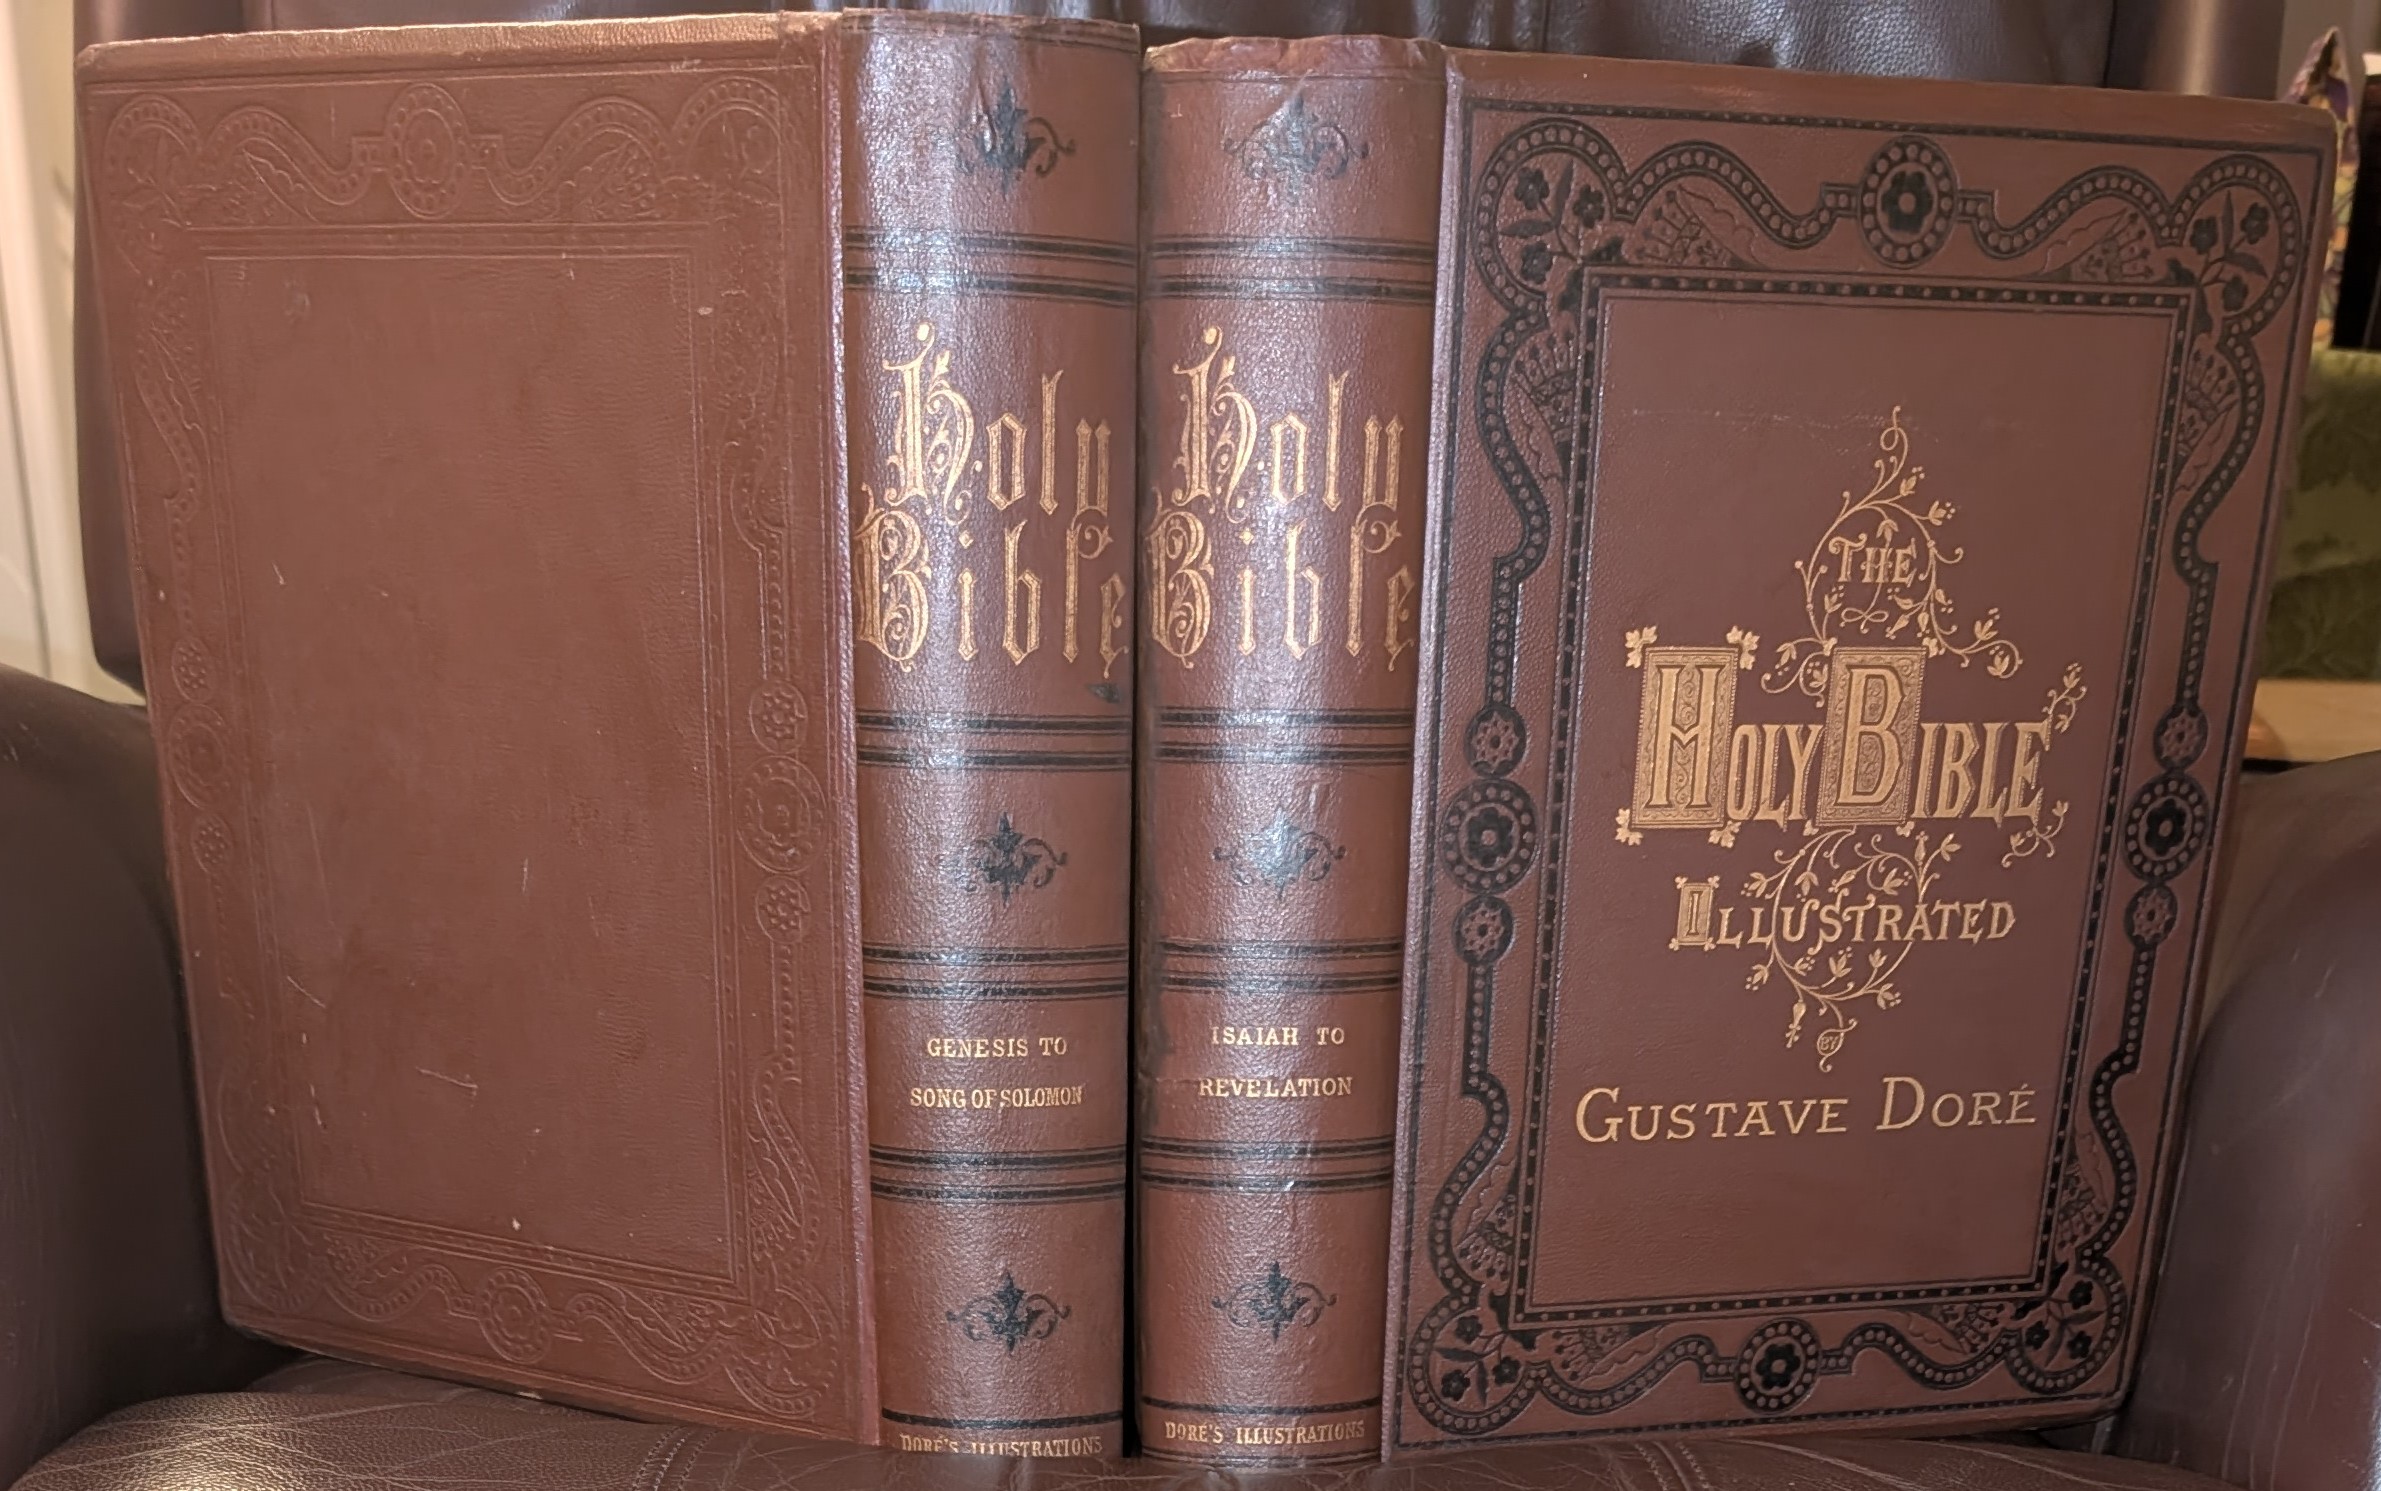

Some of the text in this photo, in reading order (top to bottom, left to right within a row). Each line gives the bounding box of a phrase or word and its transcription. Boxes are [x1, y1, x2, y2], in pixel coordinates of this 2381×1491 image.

[883, 322, 1112, 526] Holy
[1172, 326, 1404, 523] Holy
[854, 483, 1129, 678] Bible
[1144, 487, 1415, 671] Bible
[1828, 533, 1918, 588] THE
[1677, 883, 2016, 952] ILLUSTRATED
[927, 1036, 1067, 1058] GENESIS TO
[1211, 1026, 1345, 1046] ISAIAH TO
[1820, 1036, 1839, 1051] BY
[910, 1085, 1084, 1109] SONG OF SOLOMON
[1199, 1076, 1353, 1098] REVELATION
[1575, 1076, 2038, 1143] GUSTAVE DORÉ
[1164, 1419, 1365, 1445] DORÉ'S ILLUSTRATIONS
